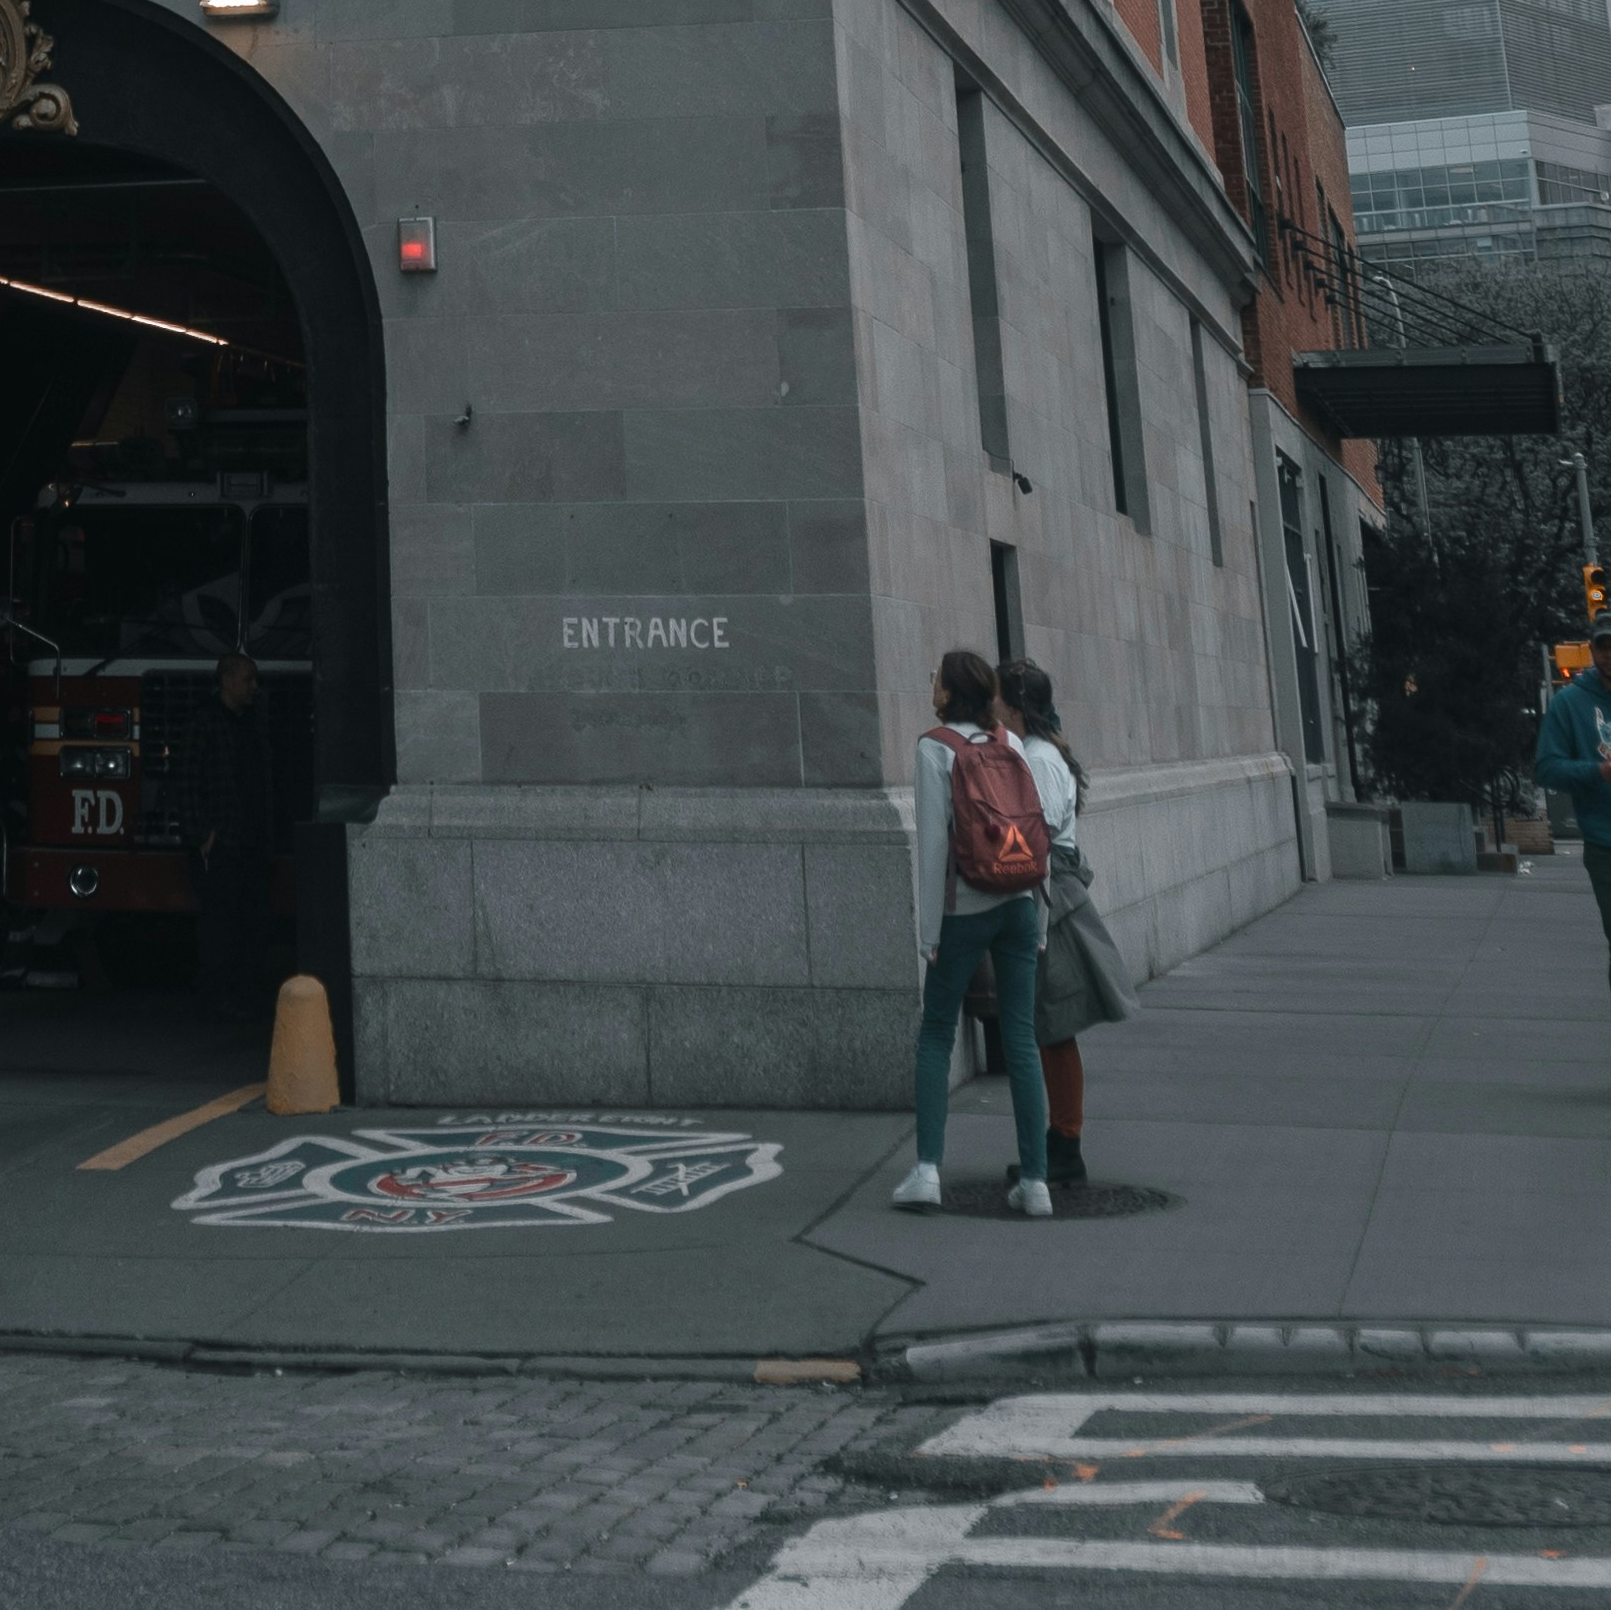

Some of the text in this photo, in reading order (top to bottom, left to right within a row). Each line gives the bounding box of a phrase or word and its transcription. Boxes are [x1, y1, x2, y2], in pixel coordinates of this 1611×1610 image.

[562, 617, 730, 649] ENTRANCE
[71, 789, 125, 835] F.D.
[993, 861, 1038, 875] Reebok
